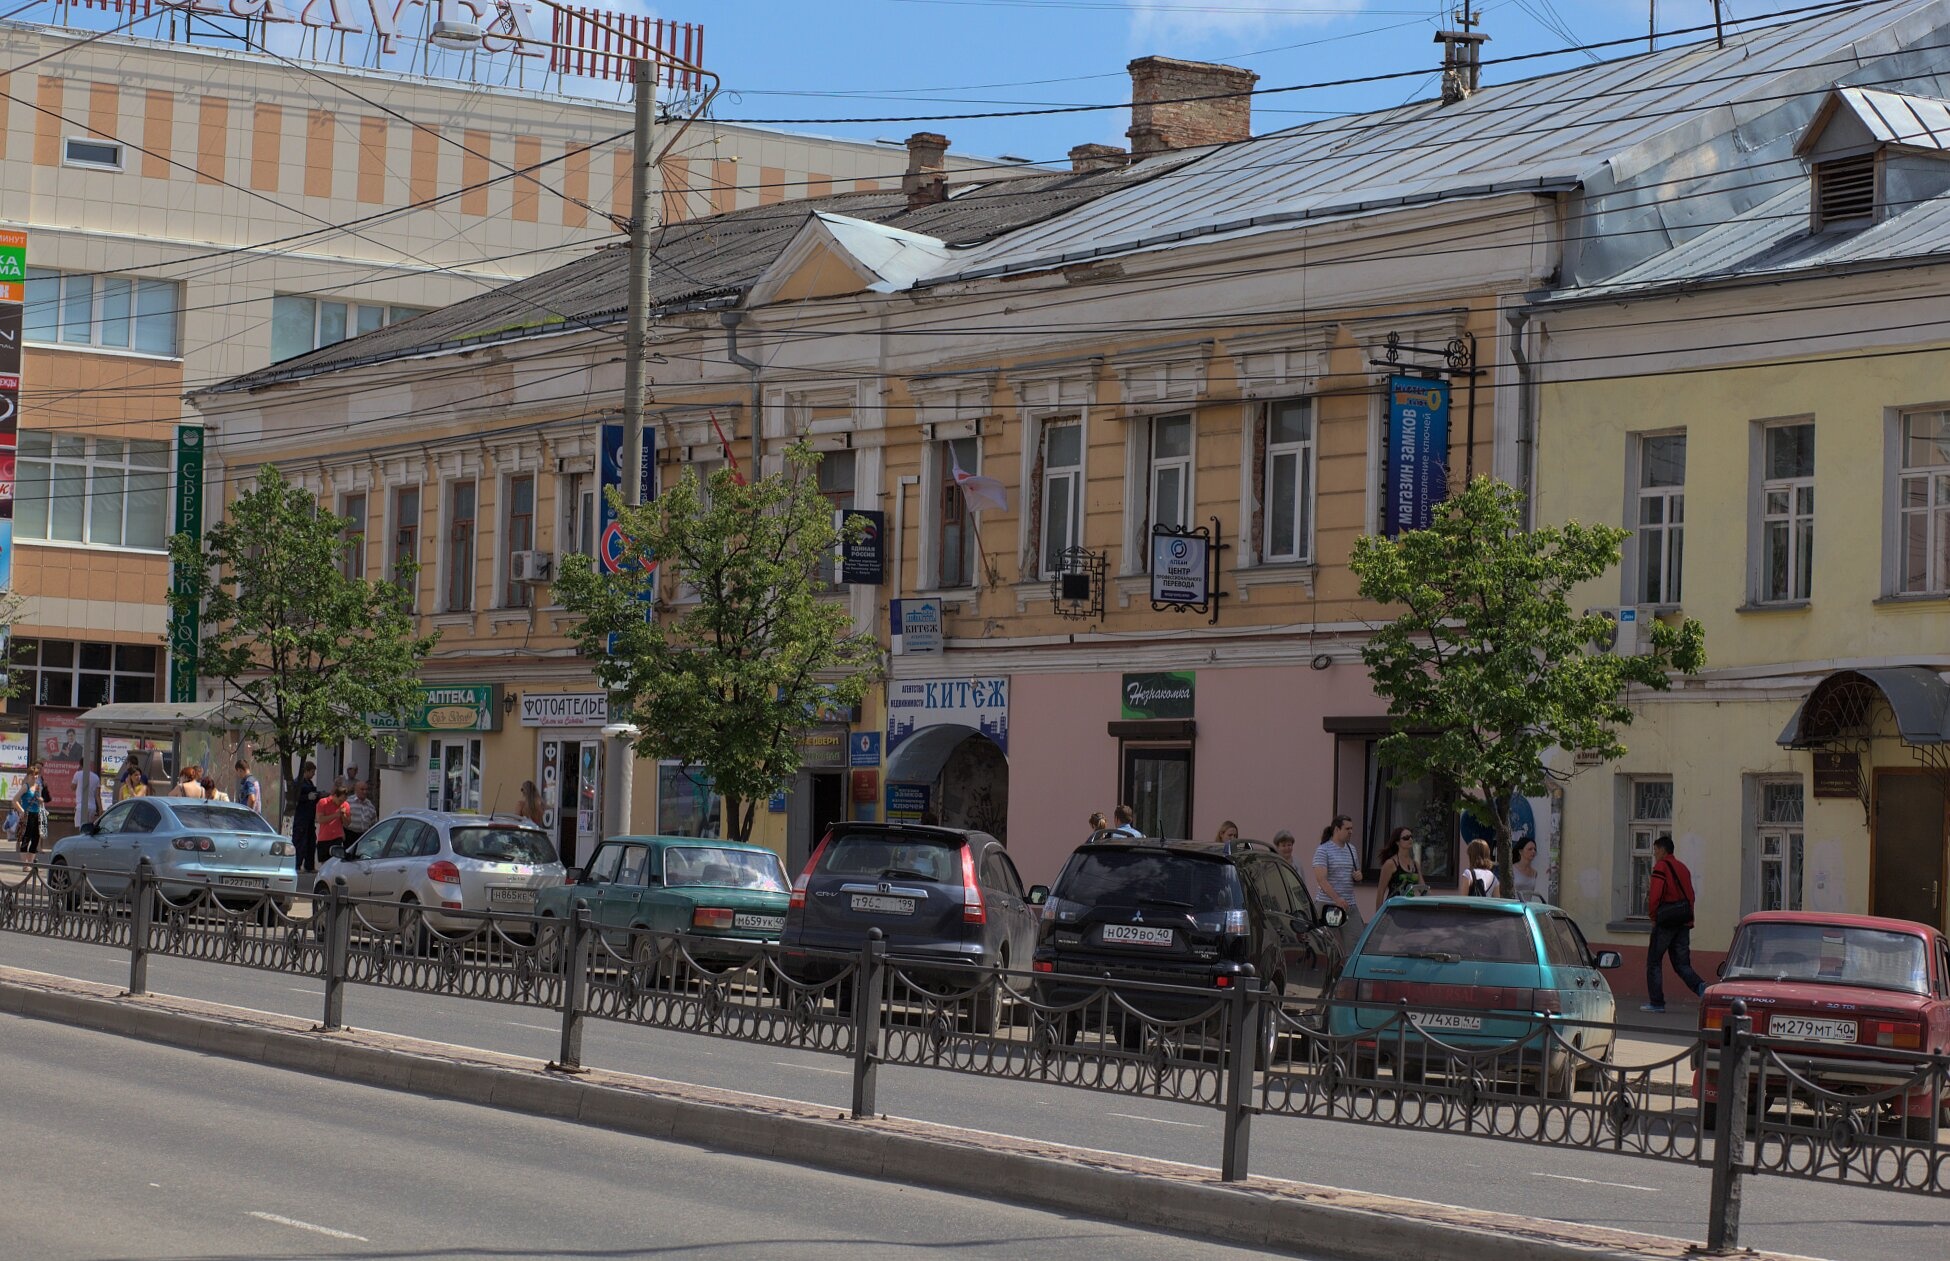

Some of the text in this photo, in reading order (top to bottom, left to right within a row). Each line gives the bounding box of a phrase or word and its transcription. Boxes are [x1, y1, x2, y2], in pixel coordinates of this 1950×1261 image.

[1421, 413, 1431, 453] ключей
[1399, 409, 1416, 524] магазин замков
[1168, 567, 1191, 575] ЦЕНТР
[1162, 580, 1195, 589] ПЕРЕВОДА
[427, 689, 475, 704] АПТЕКА
[1127, 681, 1190, 706] Незнакомка
[523, 697, 606, 716] ФОТОАТЕЛЬЕ
[370, 718, 400, 727] ЧАСА
[737, 916, 773, 927] М659УК
[1107, 926, 1170, 940] Н029ВО 40
[1776, 1019, 1850, 1037] М279МТ 40
